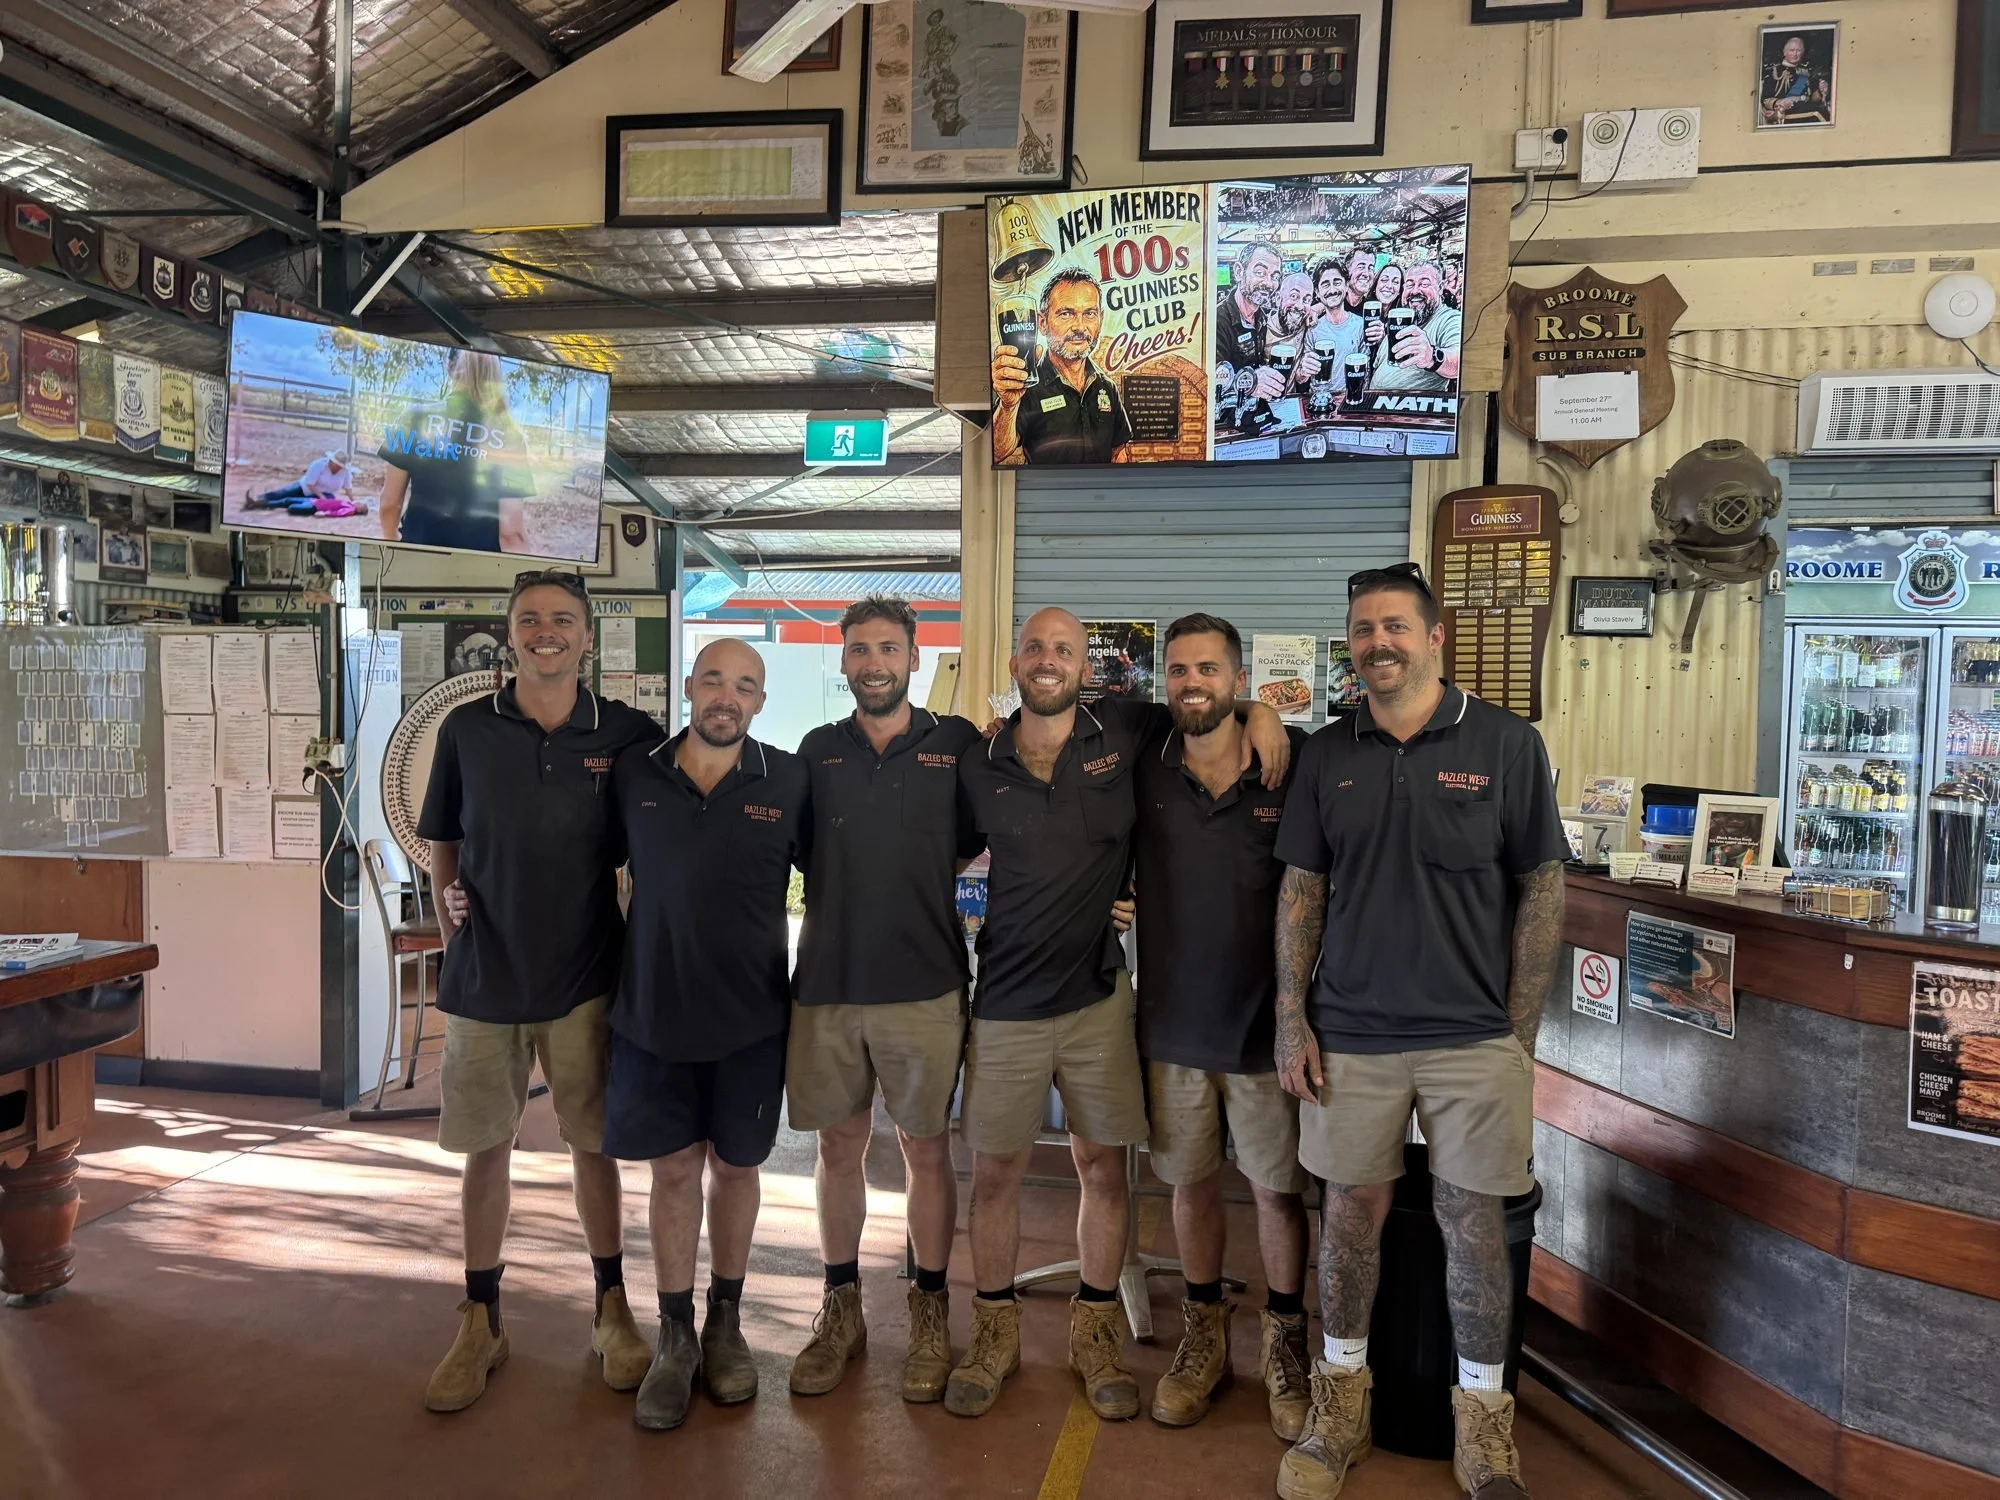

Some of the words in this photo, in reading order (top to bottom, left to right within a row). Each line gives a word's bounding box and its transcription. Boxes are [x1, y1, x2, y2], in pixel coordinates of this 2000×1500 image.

[1196, 29, 1257, 42] MEDALS
[1271, 26, 1337, 40] HONOUR
[1008, 216, 1029, 230] 100
[1057, 198, 1104, 254] NEW
[1110, 190, 1201, 229] MEMBER
[1115, 227, 1129, 239] OF
[1131, 223, 1153, 236] THE
[1106, 273, 1200, 312] GUINNESS
[1544, 287, 1637, 310] BROOME
[1126, 300, 1187, 332] CLUB
[1003, 321, 1035, 334] GUINNESS
[1535, 312, 1642, 342] R.S.L
[1105, 312, 1201, 372] Cheers!
[1539, 352, 1568, 361] SUB
[1576, 349, 1637, 360] BRANCH
[1373, 395, 1457, 414] NATH
[1559, 397, 1598, 405] September
[427, 414, 505, 449] RFDS
[384, 424, 459, 462] Walk
[438, 440, 488, 460] DCTOR
[1470, 513, 1522, 526] GUINNESS
[1786, 561, 1883, 579] ROOME
[1591, 587, 1636, 600] DUTY
[593, 600, 632, 614] ATION
[1088, 633, 1102, 645] sk
[1104, 637, 1115, 645] for
[1088, 645, 1120, 659] ngela
[1285, 658, 1311, 666] PACKS
[584, 758, 608, 768] BAZLEC
[917, 752, 942, 764] BAZLEC
[942, 754, 957, 765] WEST
[1083, 758, 1107, 773] BAZLEC
[1105, 752, 1120, 766] WEST
[1337, 780, 1353, 788] JACK
[1437, 771, 1467, 782] BAZLEC
[1468, 773, 1490, 786] WEST
[744, 804, 767, 815] BAZLEC
[768, 808, 783, 818] WEST
[1253, 807, 1277, 817] BAZLEC
[1639, 937, 1651, 945] other
[1651, 940, 1667, 949] natural
[1576, 995, 1586, 1004] NO
[1586, 998, 1614, 1013] SMOKING
[1577, 1003, 1584, 1011] IN
[1585, 1005, 1596, 1015] THIS
[1597, 1010, 1612, 1021] AREA
[1921, 1031, 1940, 1043] HAM
[1942, 1033, 1949, 1043] &
[1921, 1039, 1952, 1052] CHEESE
[1919, 1072, 1953, 1084] CHICKEN
[1919, 1080, 1949, 1091] CHEESE
[1919, 1088, 1941, 1097] MAYO
[1917, 1110, 1946, 1120] BROOME
